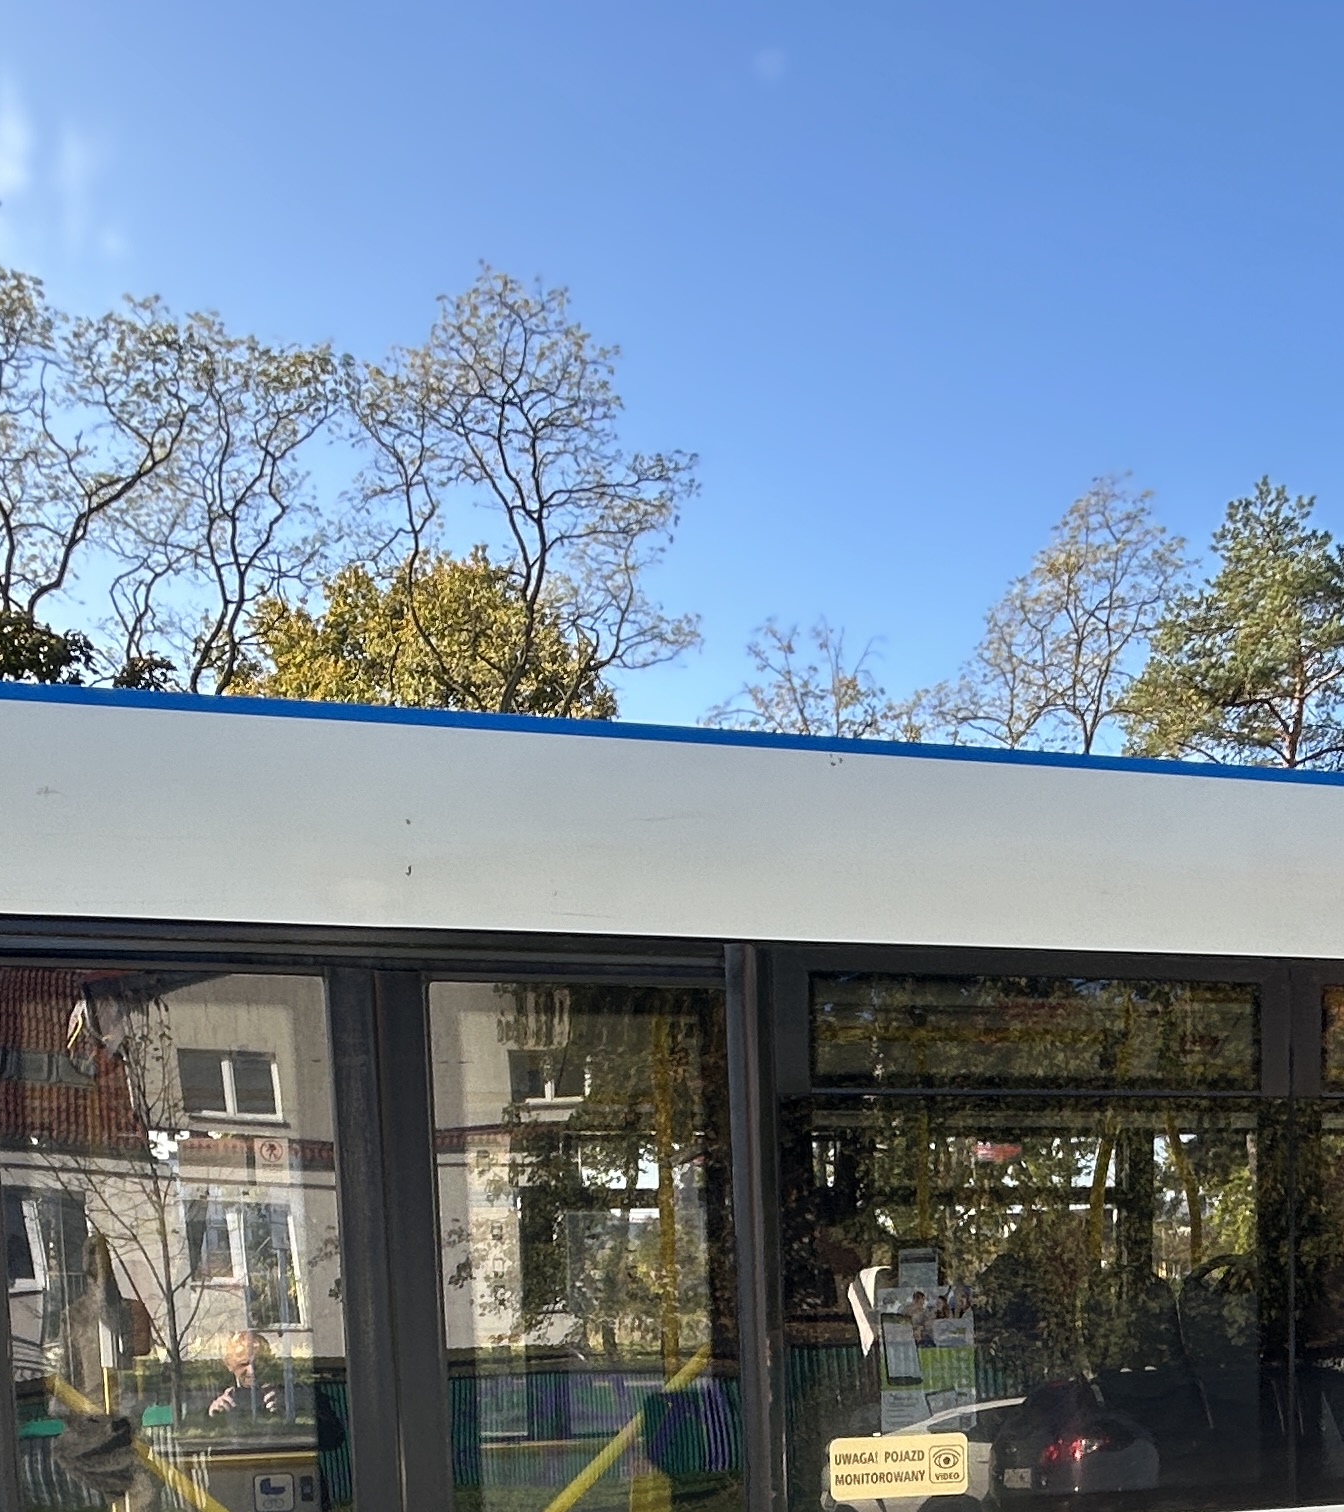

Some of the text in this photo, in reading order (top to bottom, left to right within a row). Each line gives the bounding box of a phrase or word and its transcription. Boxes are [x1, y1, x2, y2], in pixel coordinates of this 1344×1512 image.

[834, 1449, 925, 1466] UWAGA! POJAZD
[834, 1470, 926, 1486] MONITOROWANY
[934, 1472, 960, 1481] VIDEO
